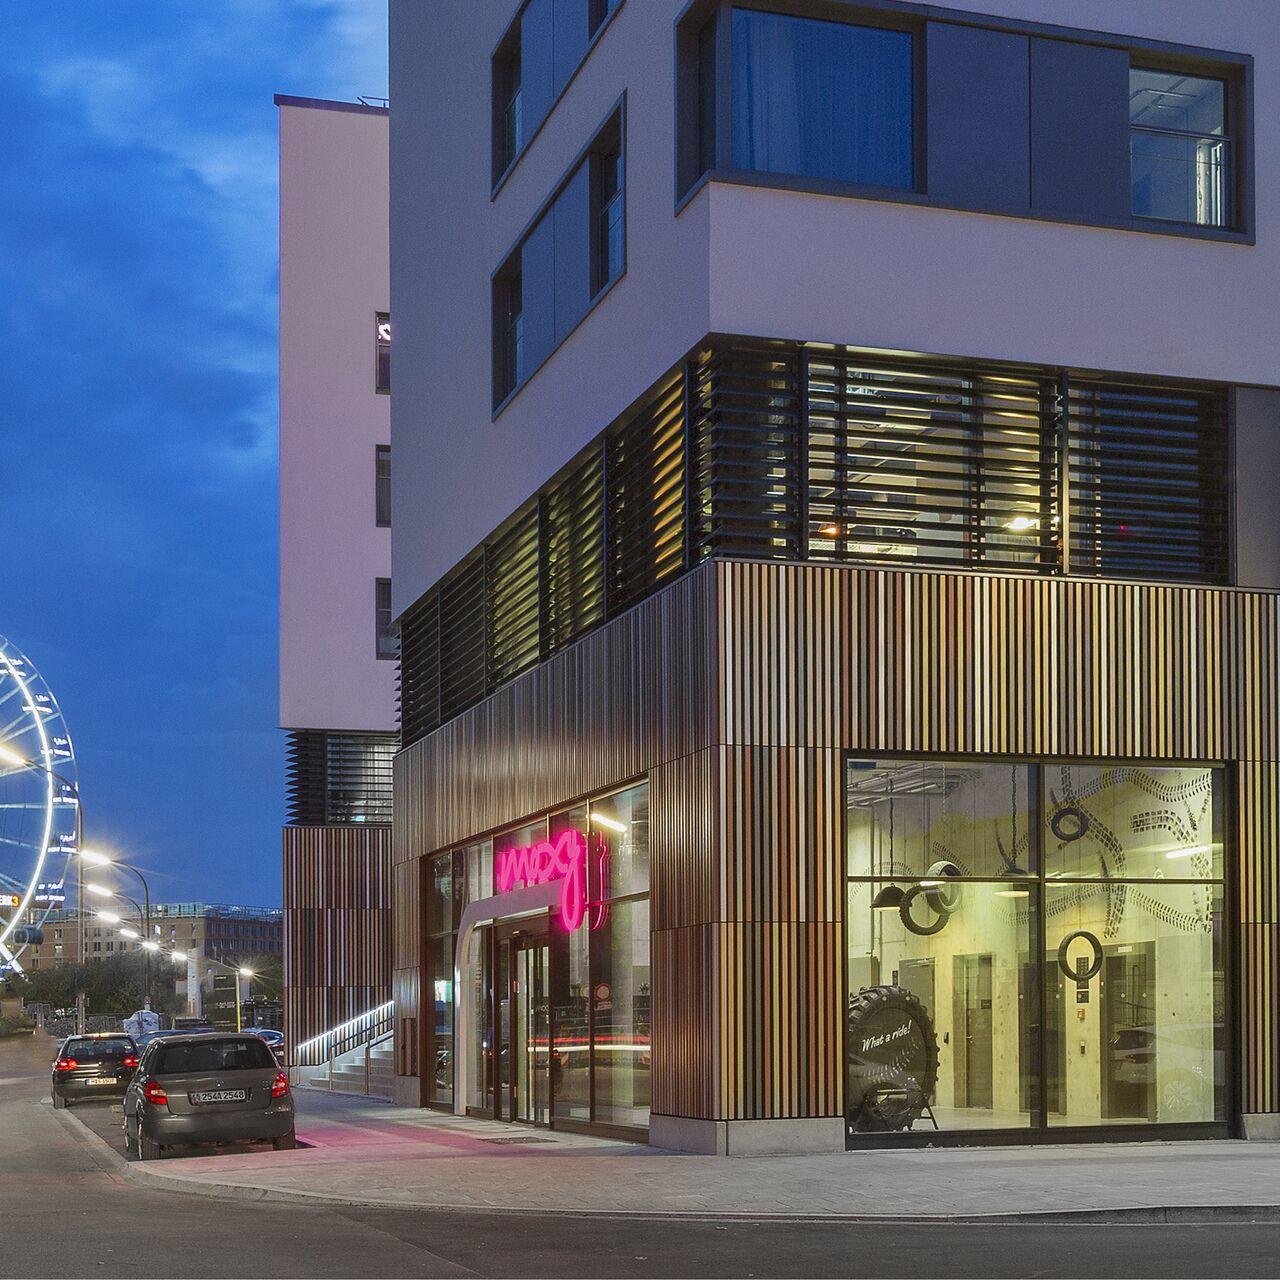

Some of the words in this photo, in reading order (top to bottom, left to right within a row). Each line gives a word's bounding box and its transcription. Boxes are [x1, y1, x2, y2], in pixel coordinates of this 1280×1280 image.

[862, 1035, 884, 1052] What
[885, 1034, 891, 1043] a
[892, 1019, 912, 1040] ride!
